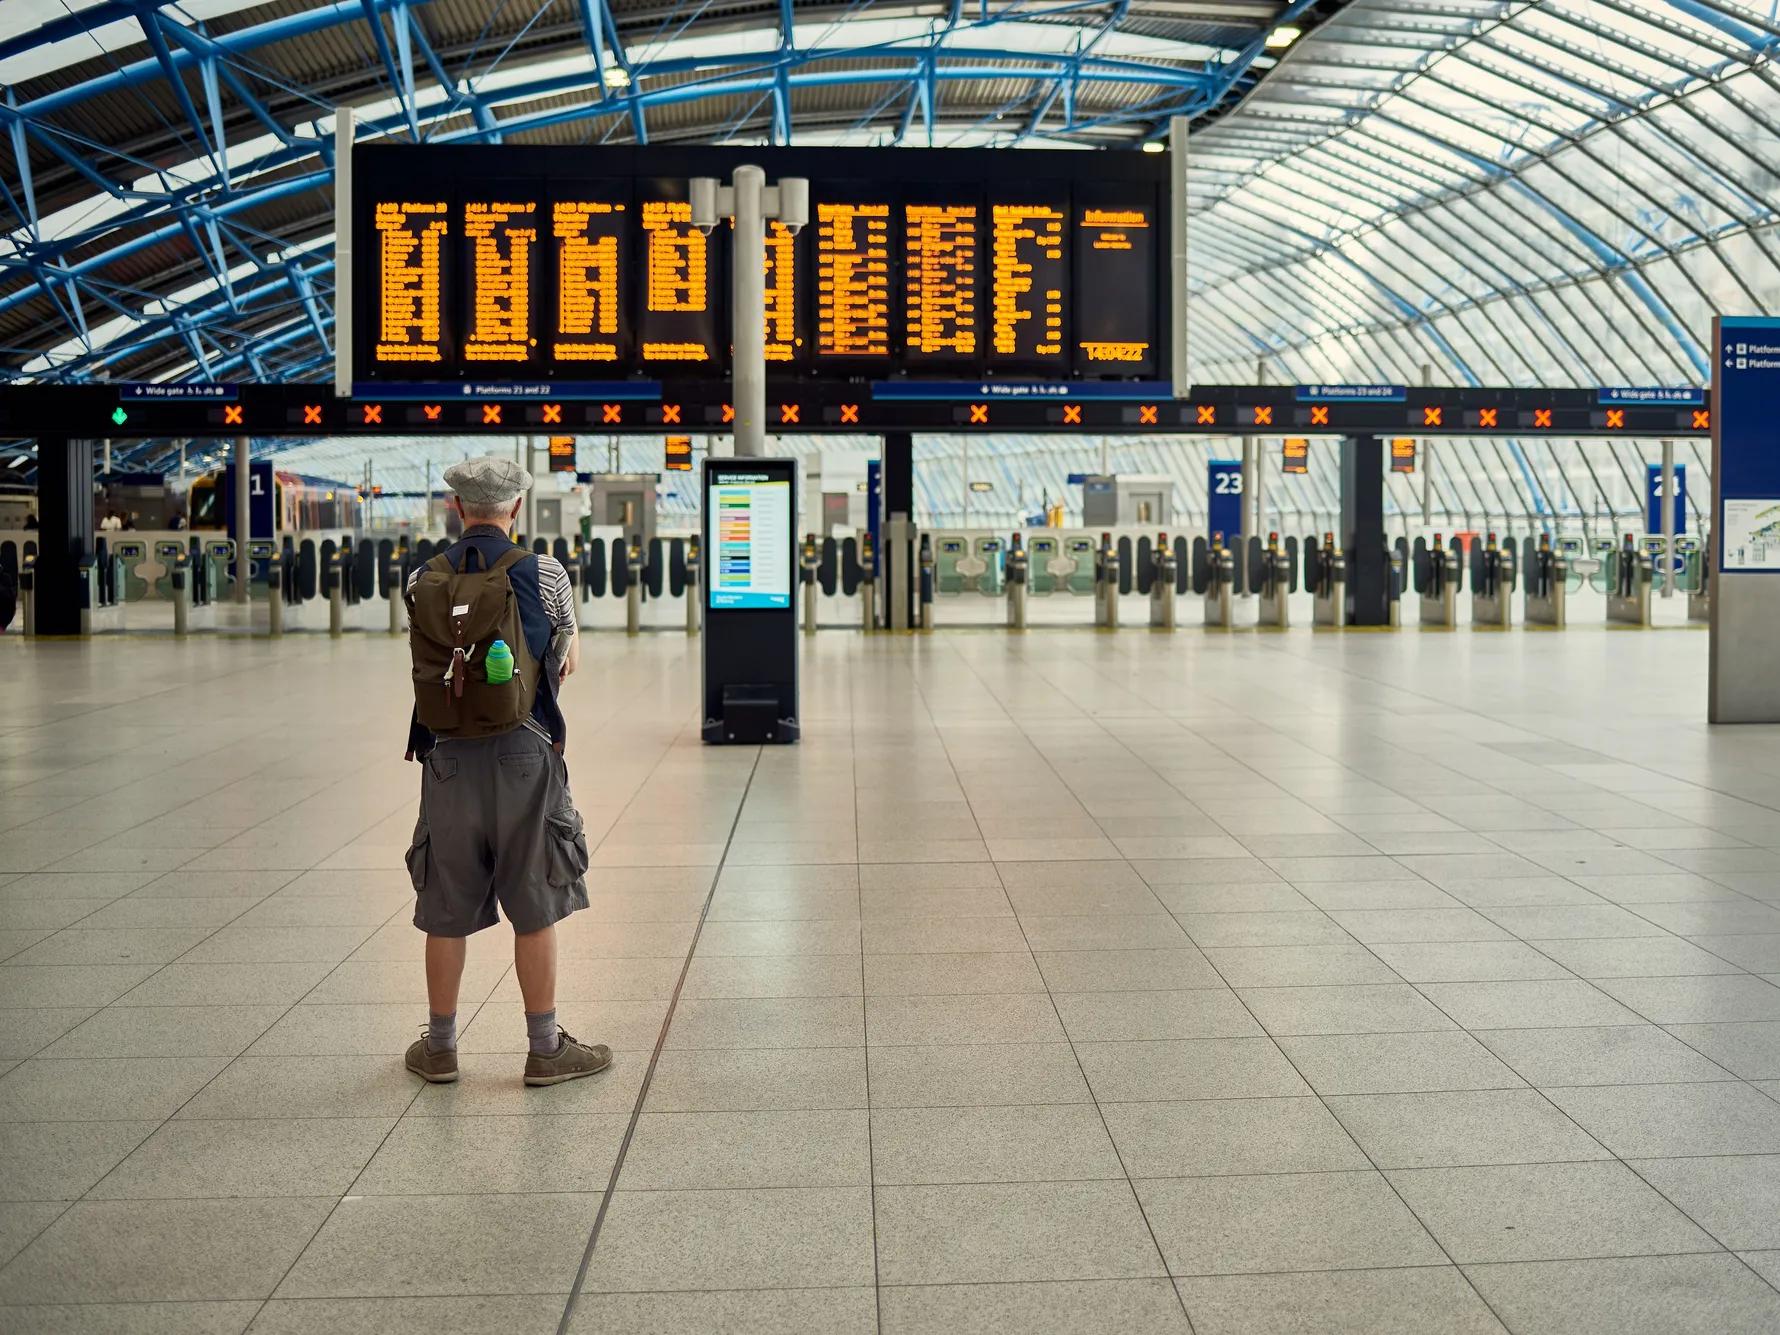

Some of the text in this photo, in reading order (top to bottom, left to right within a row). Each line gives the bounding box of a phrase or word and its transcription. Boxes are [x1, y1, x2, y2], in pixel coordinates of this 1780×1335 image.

[145, 386, 185, 397] Wide gate
[475, 385, 512, 395] Platforms
[251, 474, 265, 496] 1
[1215, 472, 1243, 495] 23
